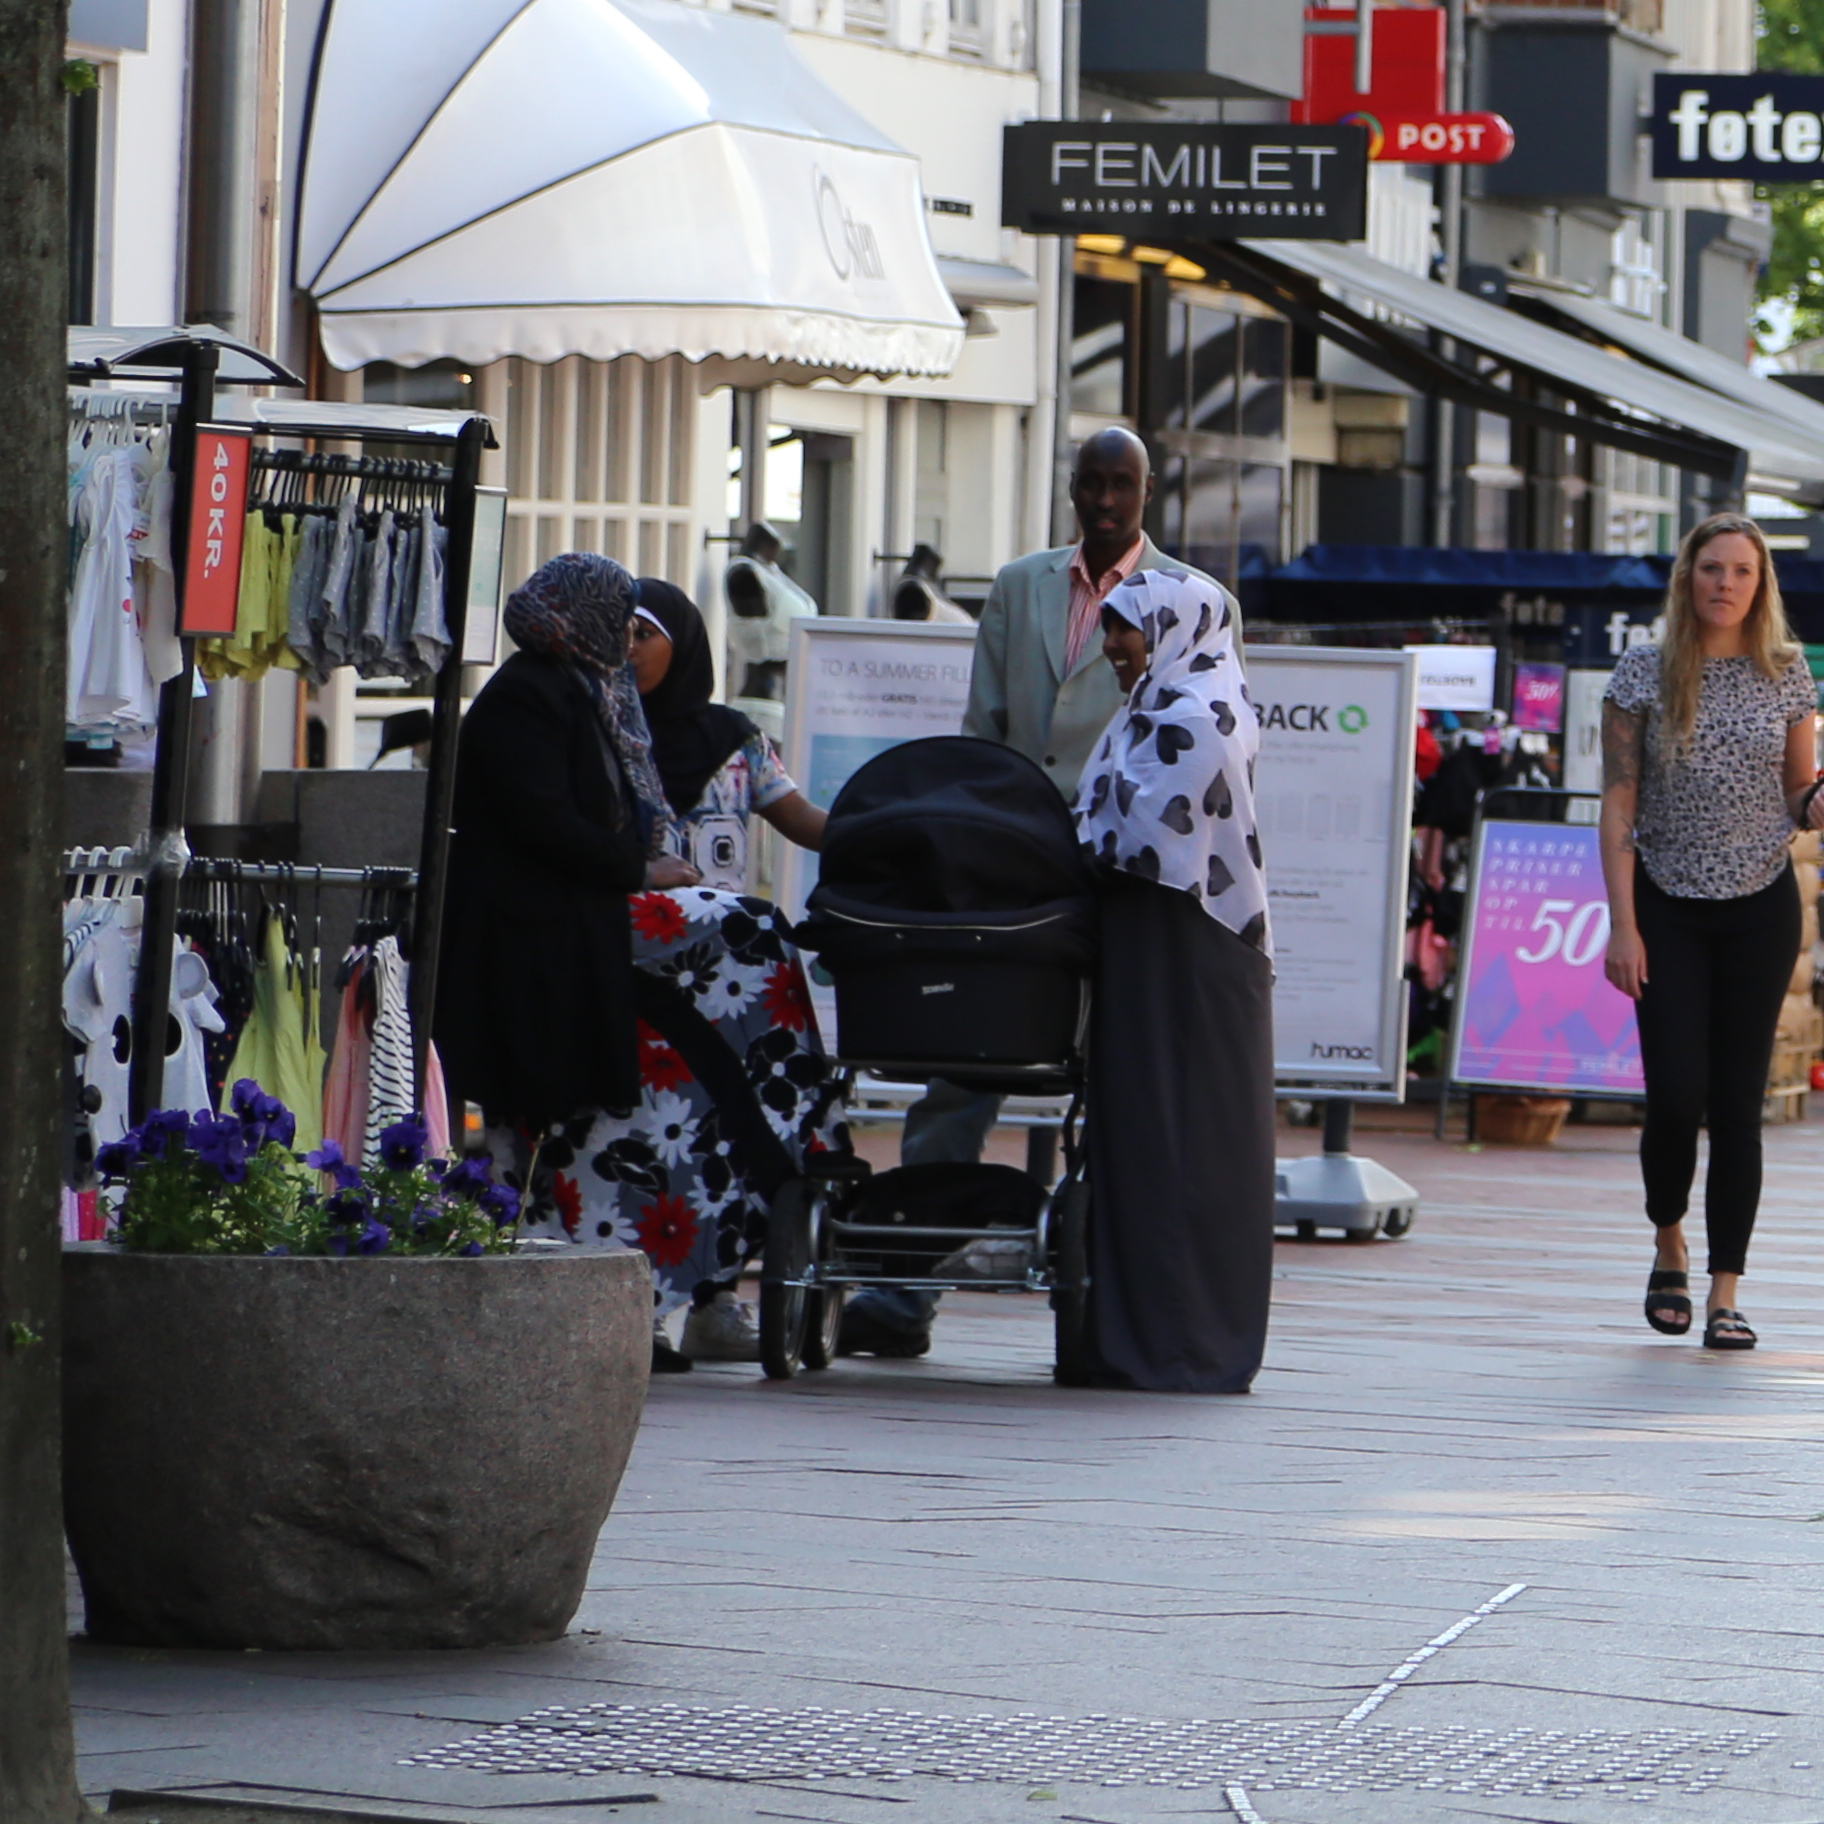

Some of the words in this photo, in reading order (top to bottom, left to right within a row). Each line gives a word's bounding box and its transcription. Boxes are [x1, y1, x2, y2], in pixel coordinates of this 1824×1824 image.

[1398, 122, 1486, 153] POST
[1052, 142, 1337, 190] FEMILET
[1061, 198, 1154, 214] MAISON
[1167, 199, 1196, 215] DE
[1211, 200, 1327, 217] LINGERIE
[848, 661, 859, 676] A
[864, 661, 937, 681] SUMMER
[1492, 838, 1589, 859] SKARPE
[1488, 857, 1583, 877] PRISER
[1488, 878, 1548, 895] SPAR
[1310, 1041, 1373, 1060] humac
